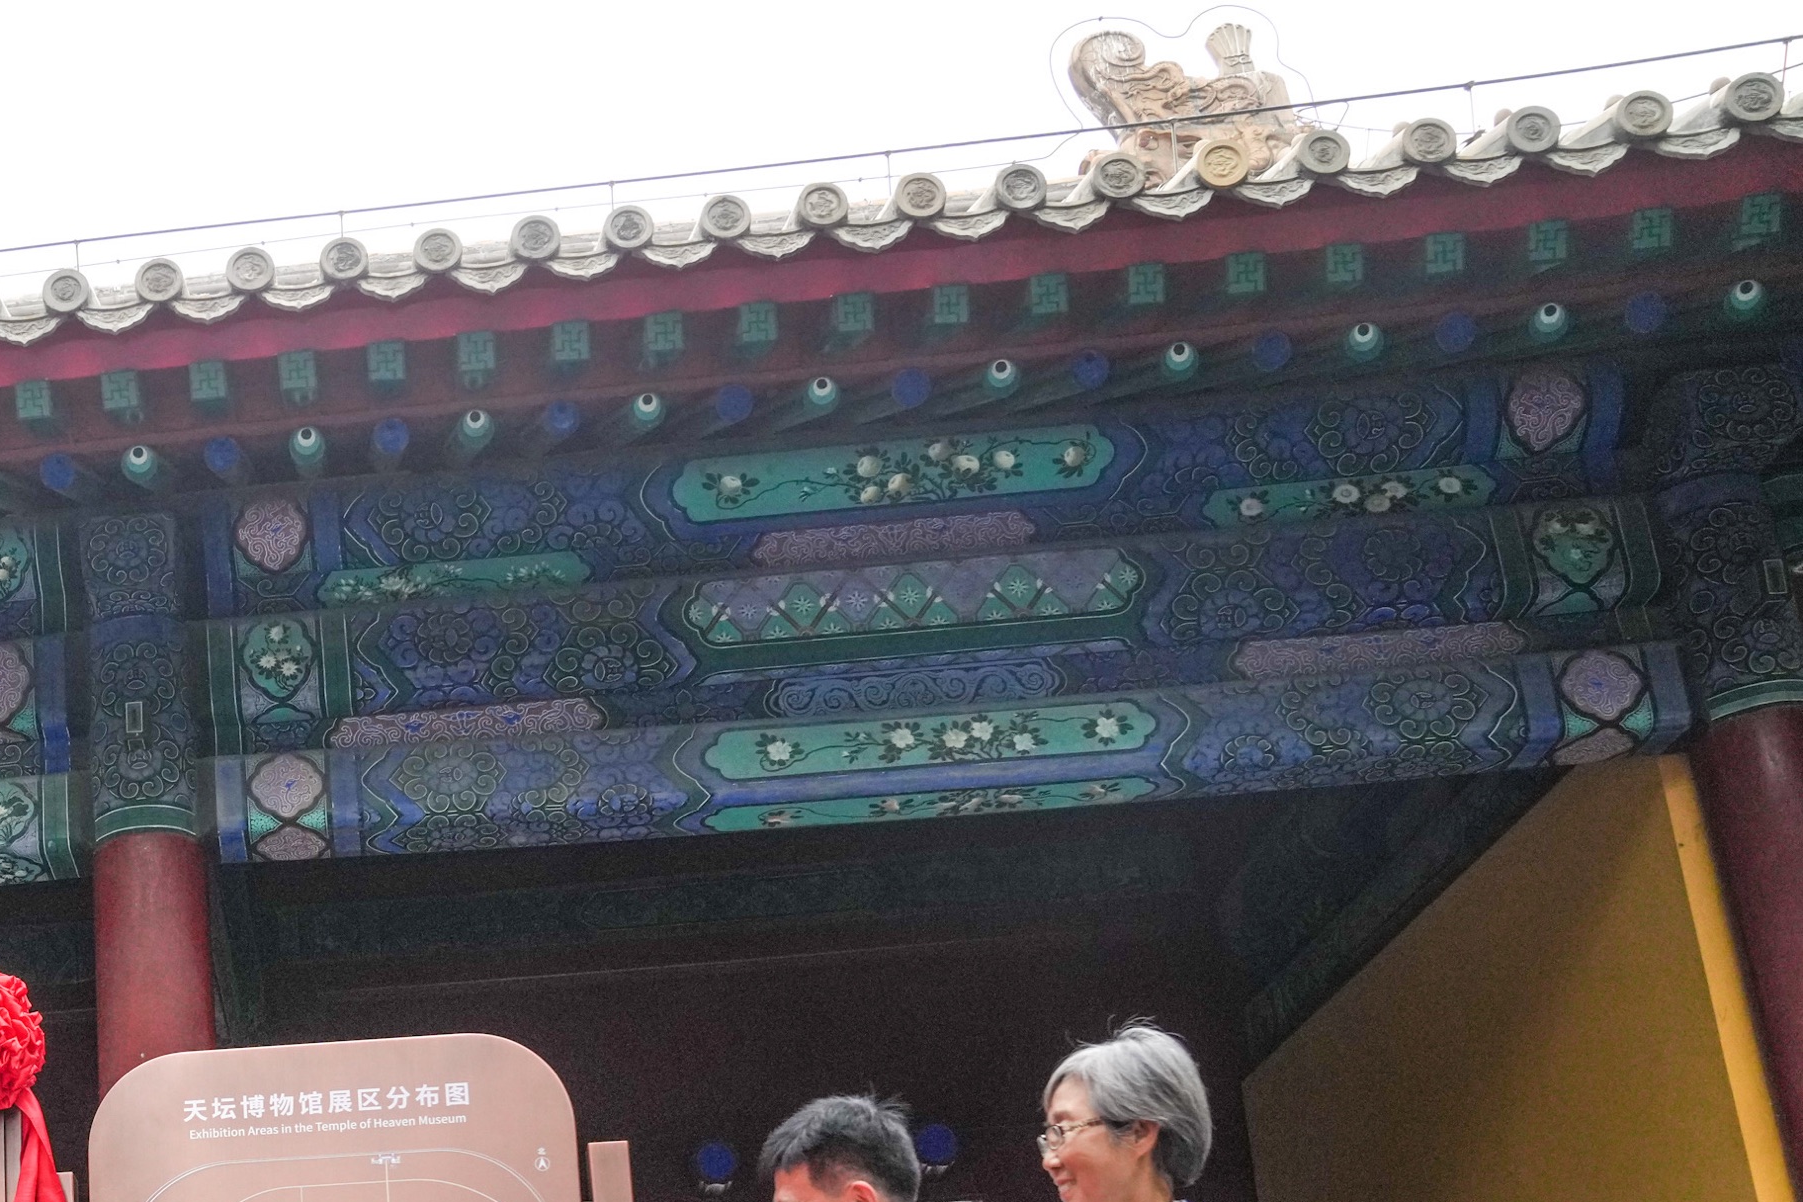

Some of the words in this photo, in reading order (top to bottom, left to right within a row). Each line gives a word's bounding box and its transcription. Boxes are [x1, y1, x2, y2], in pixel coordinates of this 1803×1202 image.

[183, 1082, 470, 1123] 天坛博物馆展区分布图
[189, 1126, 246, 1140] Exhibition
[248, 1124, 279, 1136] Areas
[281, 1123, 292, 1134] in
[294, 1122, 313, 1133] the
[315, 1119, 357, 1133] Temple
[360, 1117, 373, 1130] of
[373, 1116, 416, 1128] Heaven
[418, 1113, 467, 1126] Museum
